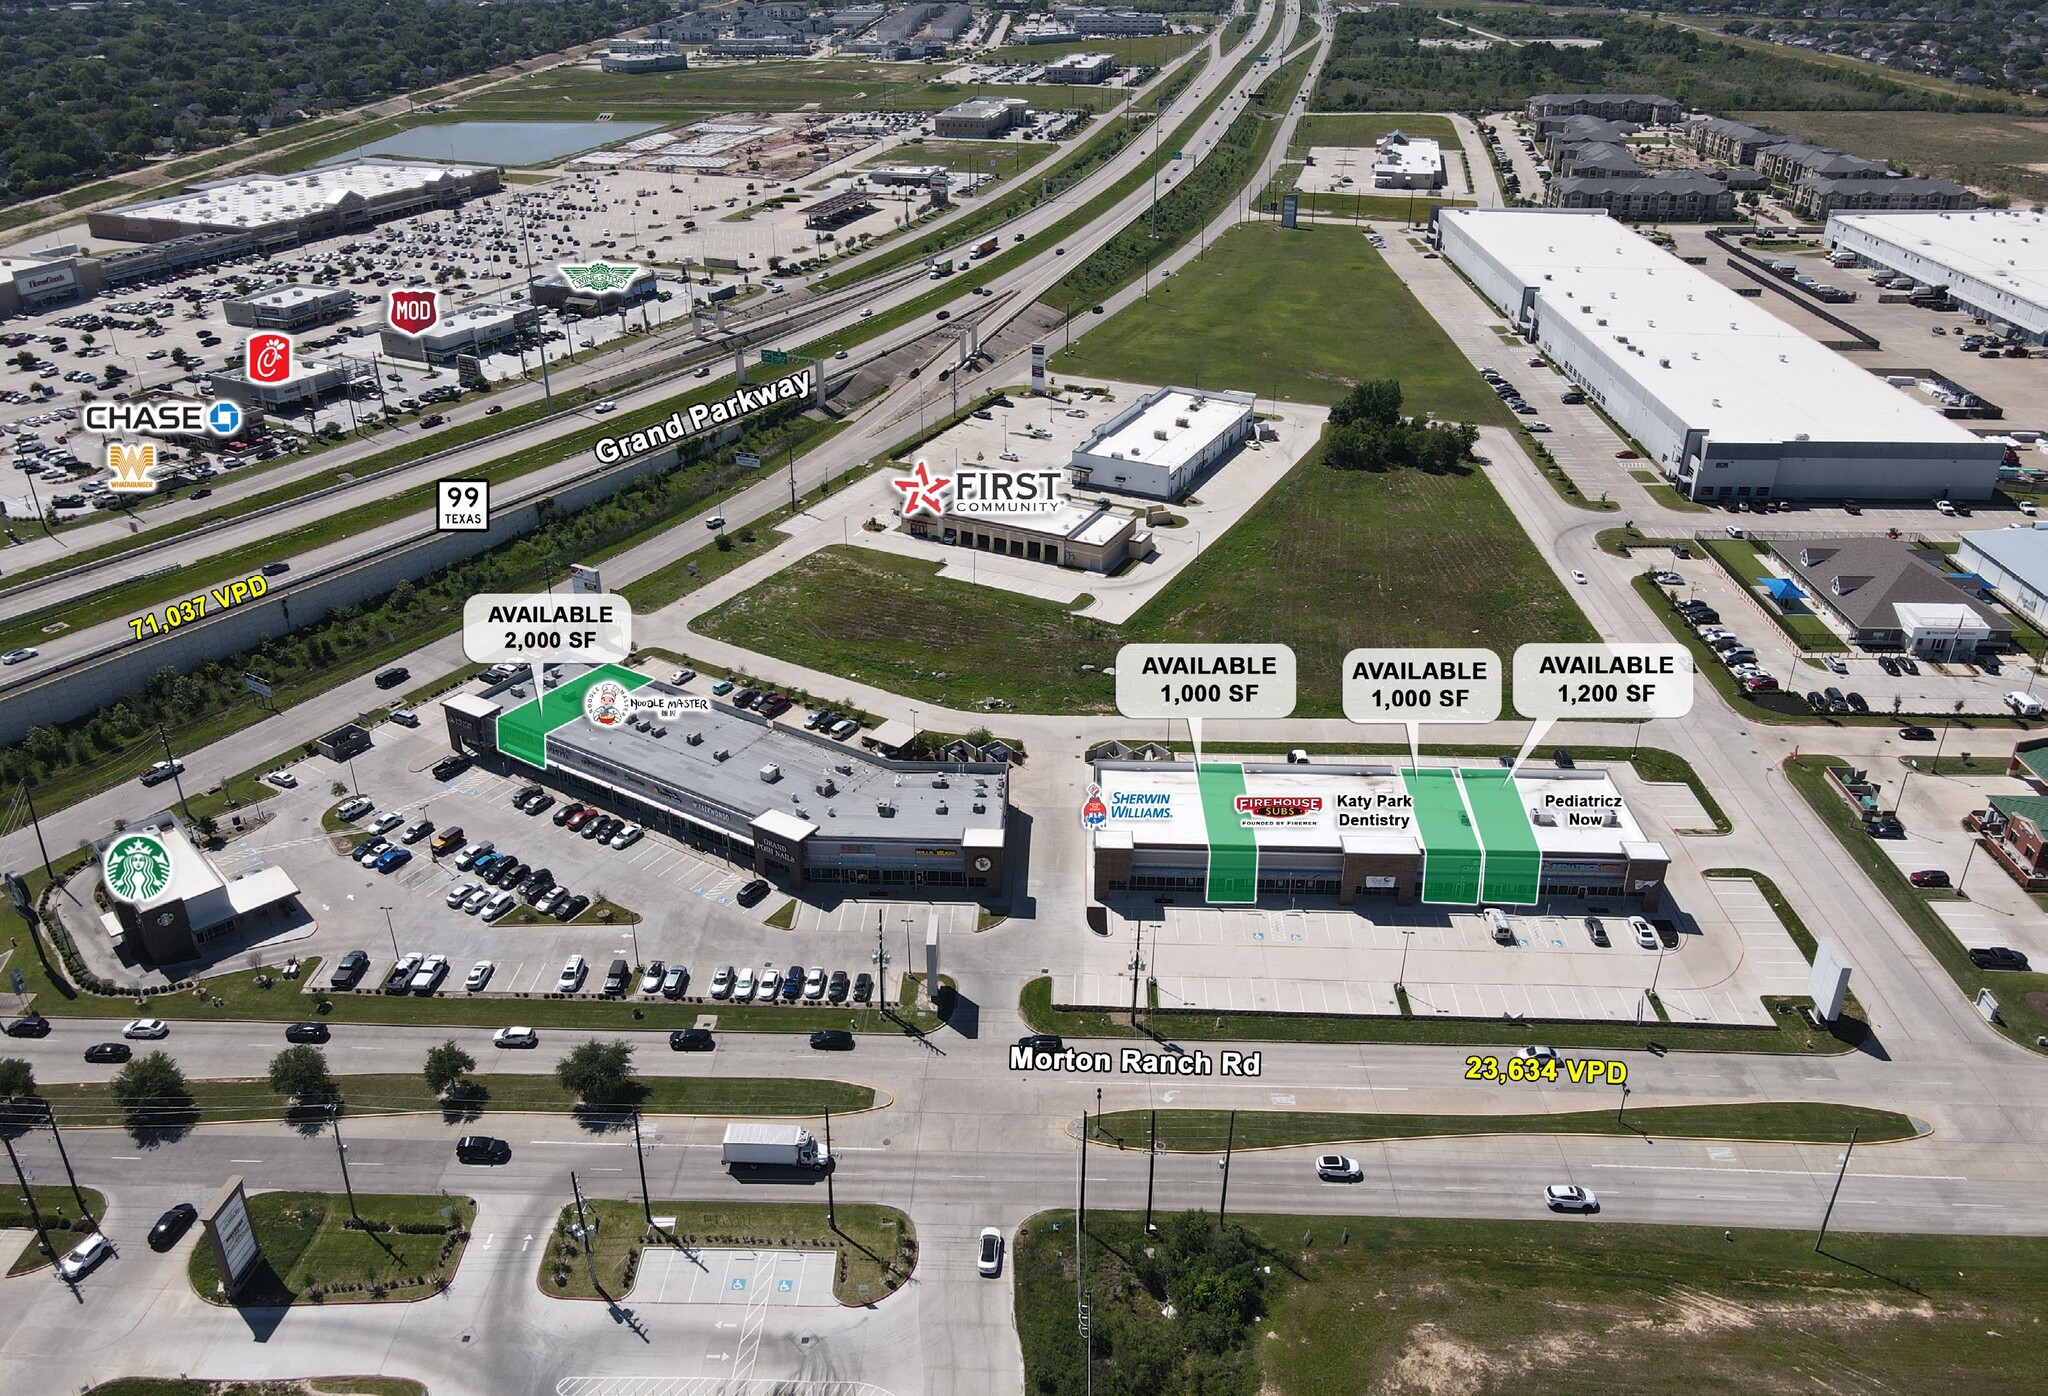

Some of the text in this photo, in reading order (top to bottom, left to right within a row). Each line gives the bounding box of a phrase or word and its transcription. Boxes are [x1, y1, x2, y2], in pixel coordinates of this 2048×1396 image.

[698, 803, 730, 822] TAEKWONDO
[756, 842, 796, 863] POSH NAILS
[763, 838, 787, 853] GRAND
